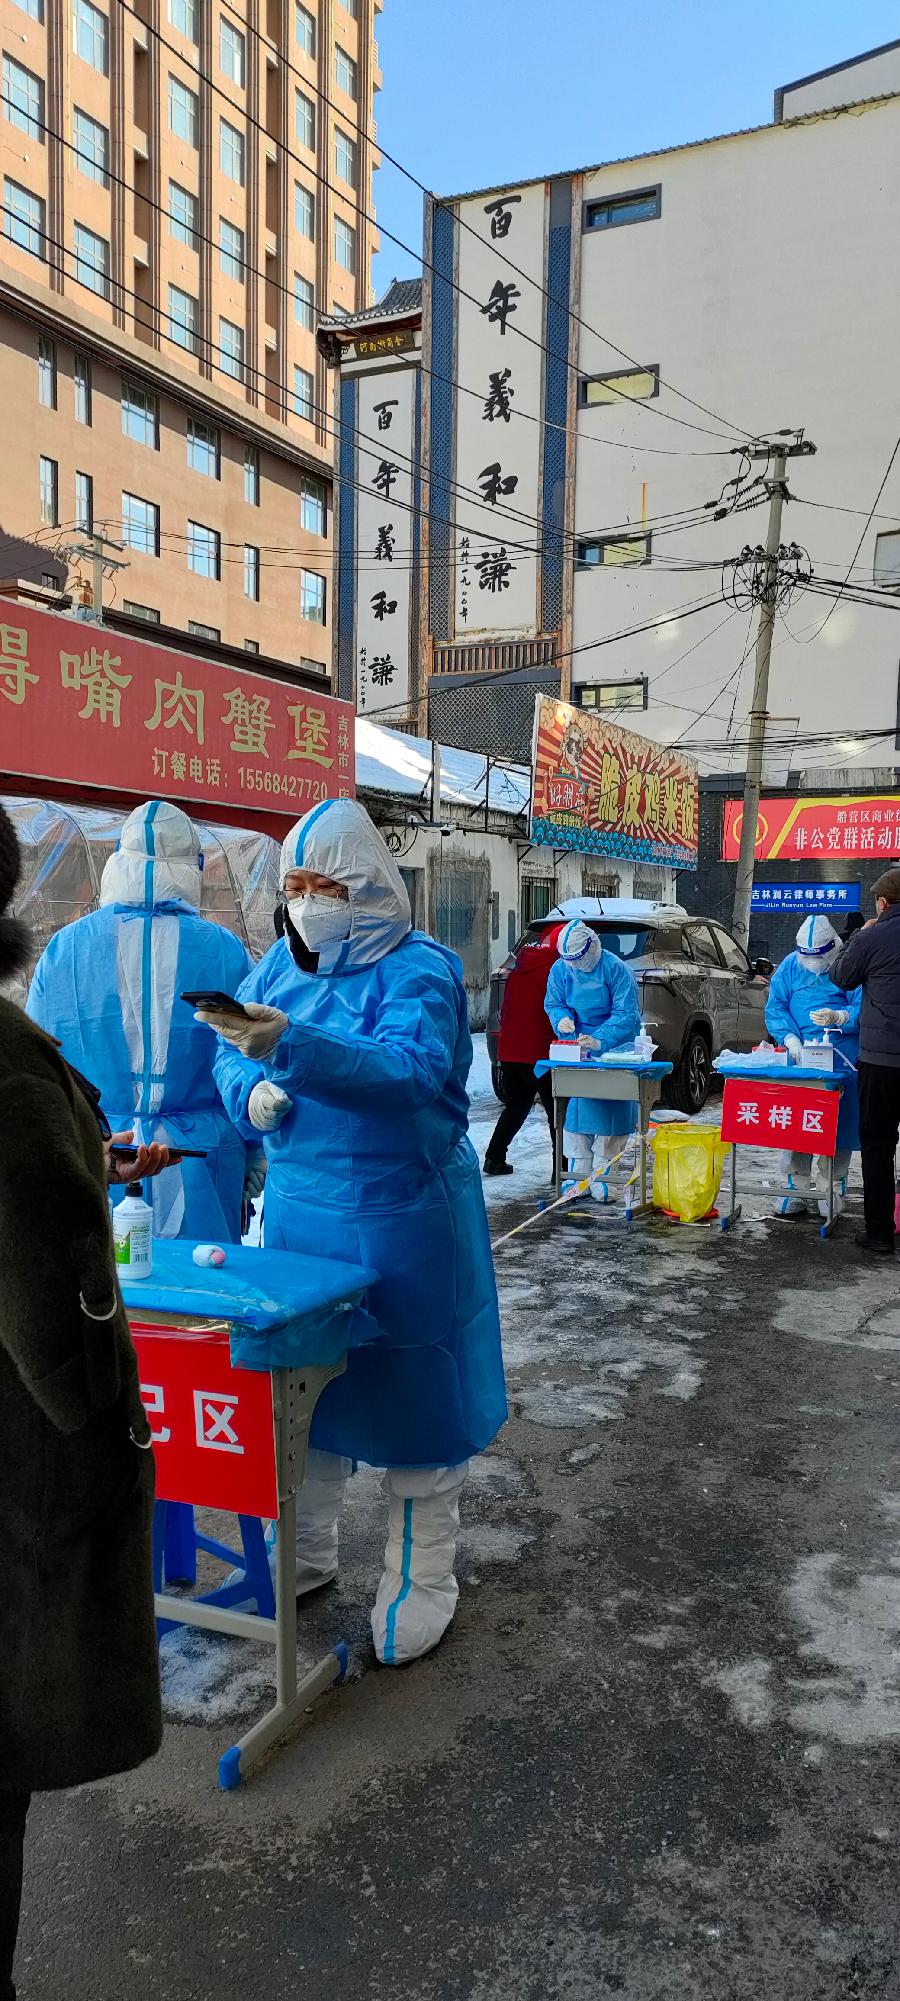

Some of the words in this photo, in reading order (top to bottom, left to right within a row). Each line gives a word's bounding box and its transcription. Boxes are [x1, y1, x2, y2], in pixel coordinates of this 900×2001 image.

[597, 751, 694, 840] 脆皮鸡米饭
[736, 1101, 825, 1134] 采样区
